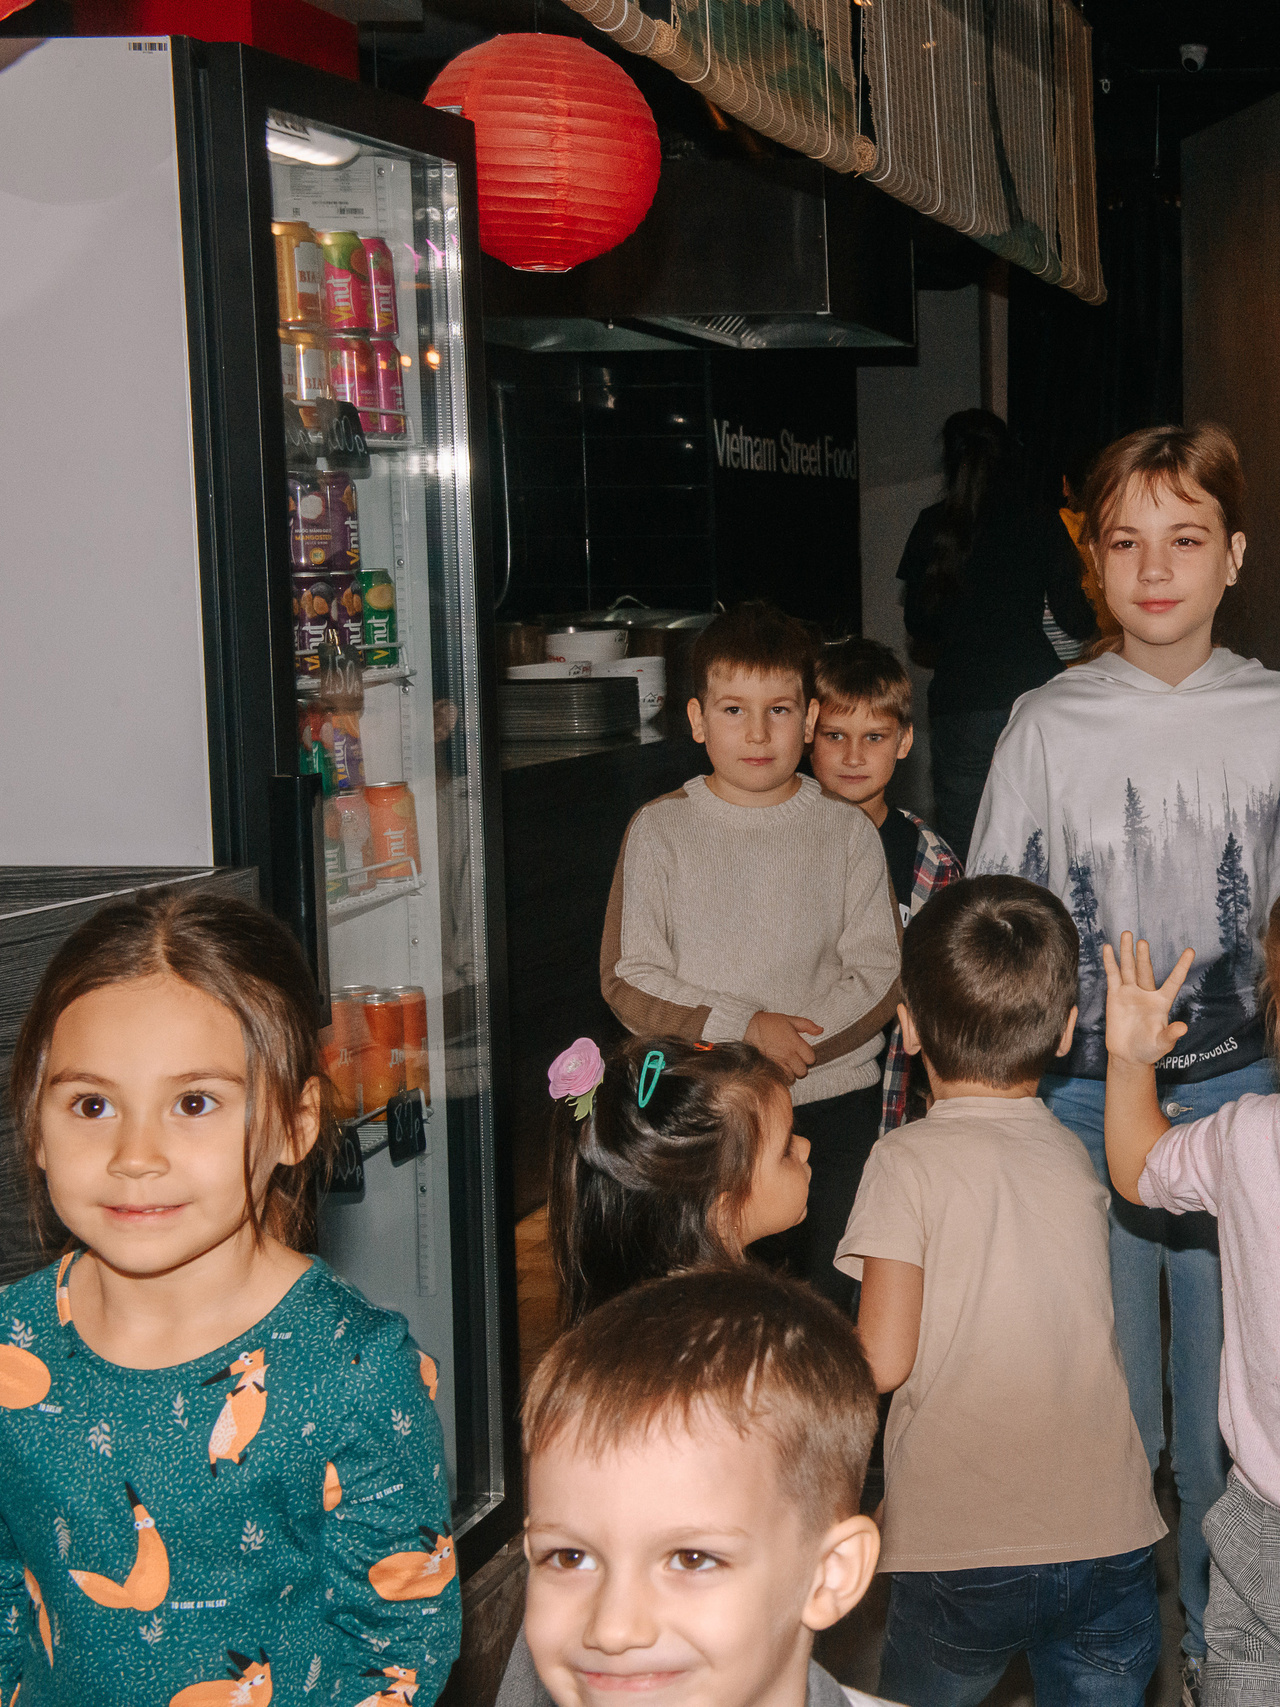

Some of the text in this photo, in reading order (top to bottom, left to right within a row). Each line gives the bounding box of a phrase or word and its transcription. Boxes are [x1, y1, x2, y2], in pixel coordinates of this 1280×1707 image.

[713, 419, 857, 480] Vietnam Street Food
